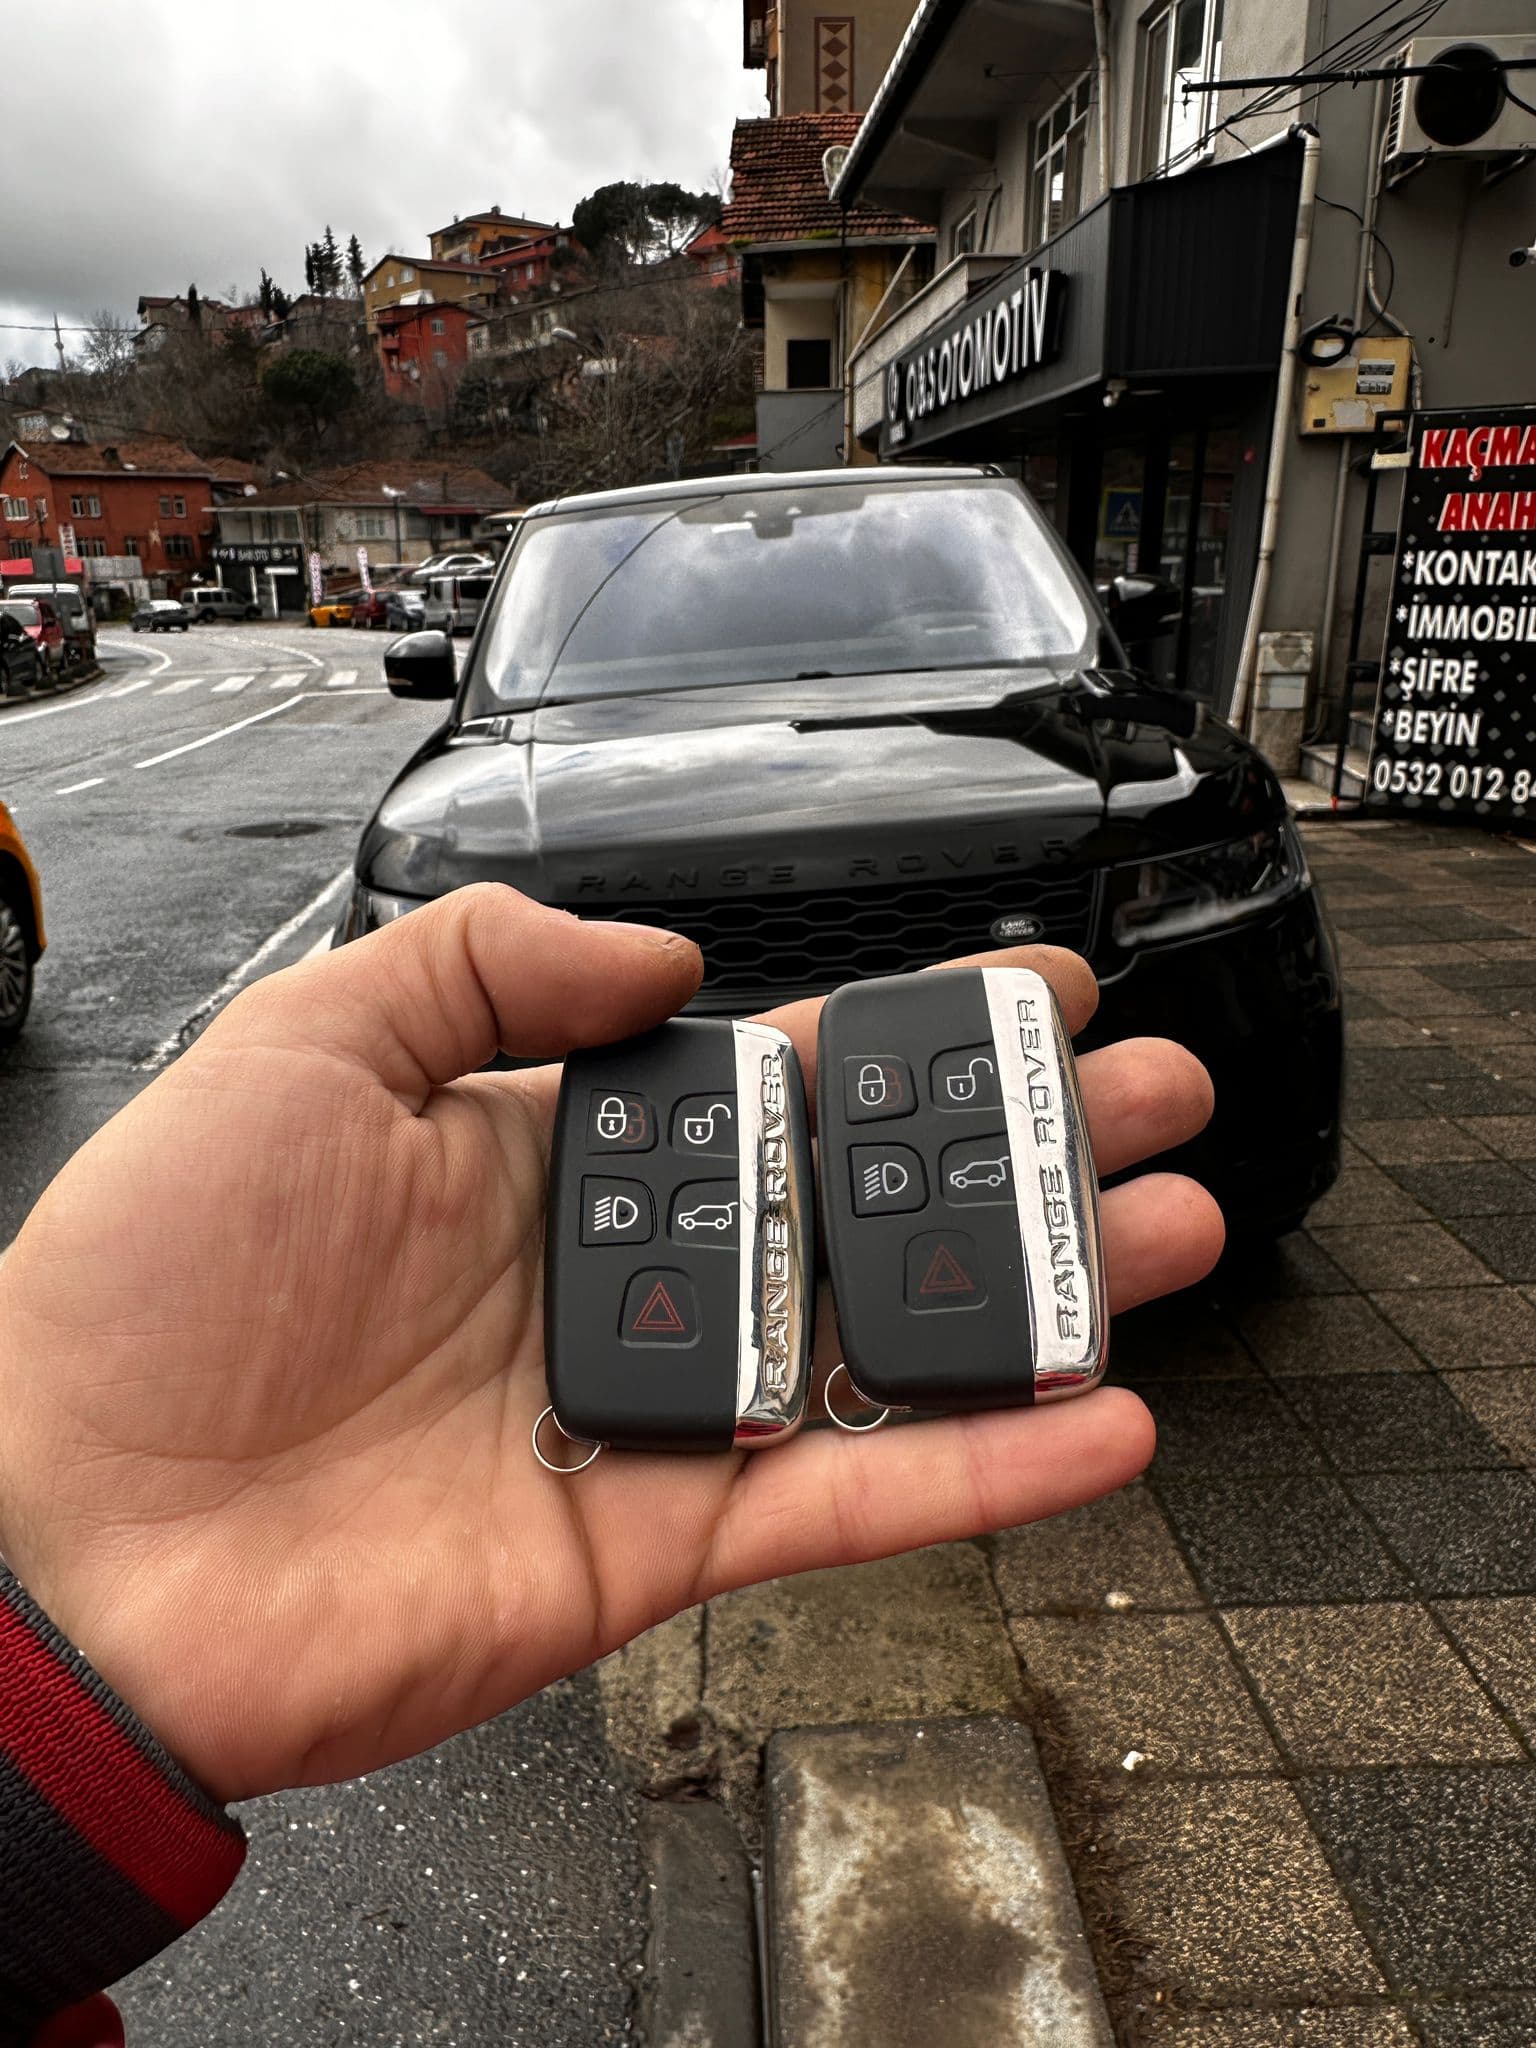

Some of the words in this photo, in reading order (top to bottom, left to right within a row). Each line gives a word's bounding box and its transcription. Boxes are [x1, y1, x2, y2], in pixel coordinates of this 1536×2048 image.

[1419, 425, 1536, 482] KAÇMA
[1436, 491, 1536, 532] ANAH
[1373, 758, 1443, 796] 0532
[1450, 764, 1505, 801] 012
[577, 864, 797, 894] RANGE
[848, 838, 1074, 878] ROVER
[1017, 998, 1056, 1148] ROVER
[761, 1053, 788, 1202] ROVER
[1039, 1163, 1082, 1341] RANGE
[764, 1216, 789, 1393] RANGE
